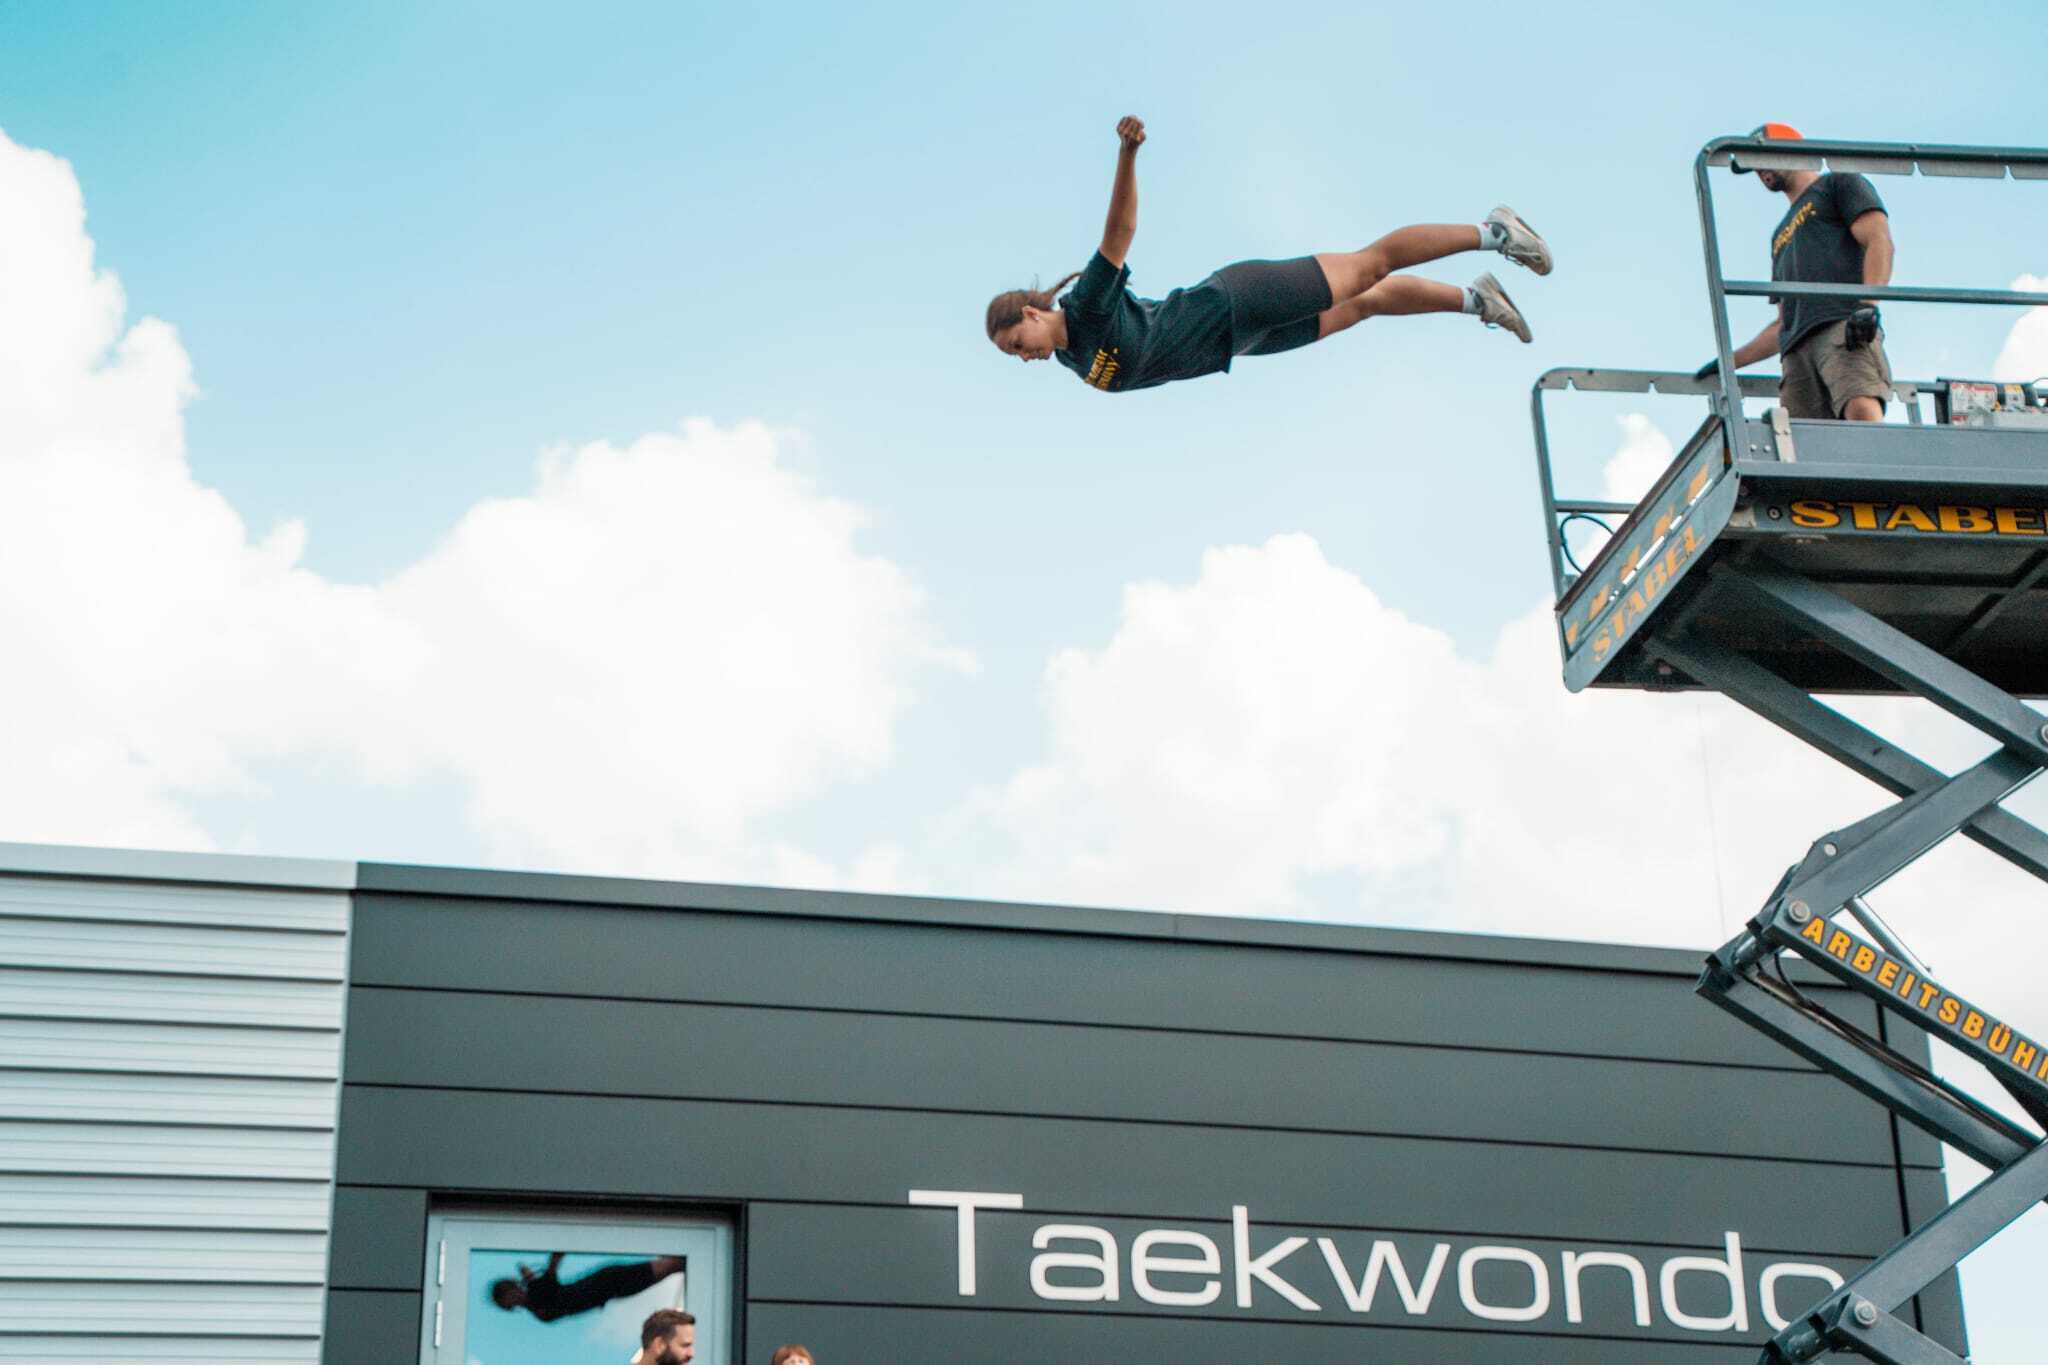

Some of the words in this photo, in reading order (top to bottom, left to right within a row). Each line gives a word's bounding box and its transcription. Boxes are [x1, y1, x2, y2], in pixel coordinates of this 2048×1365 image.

[1790, 500, 2048, 535] STABE
[1592, 526, 1704, 662] STABEL
[908, 1190, 1845, 1332] Taekwondo
